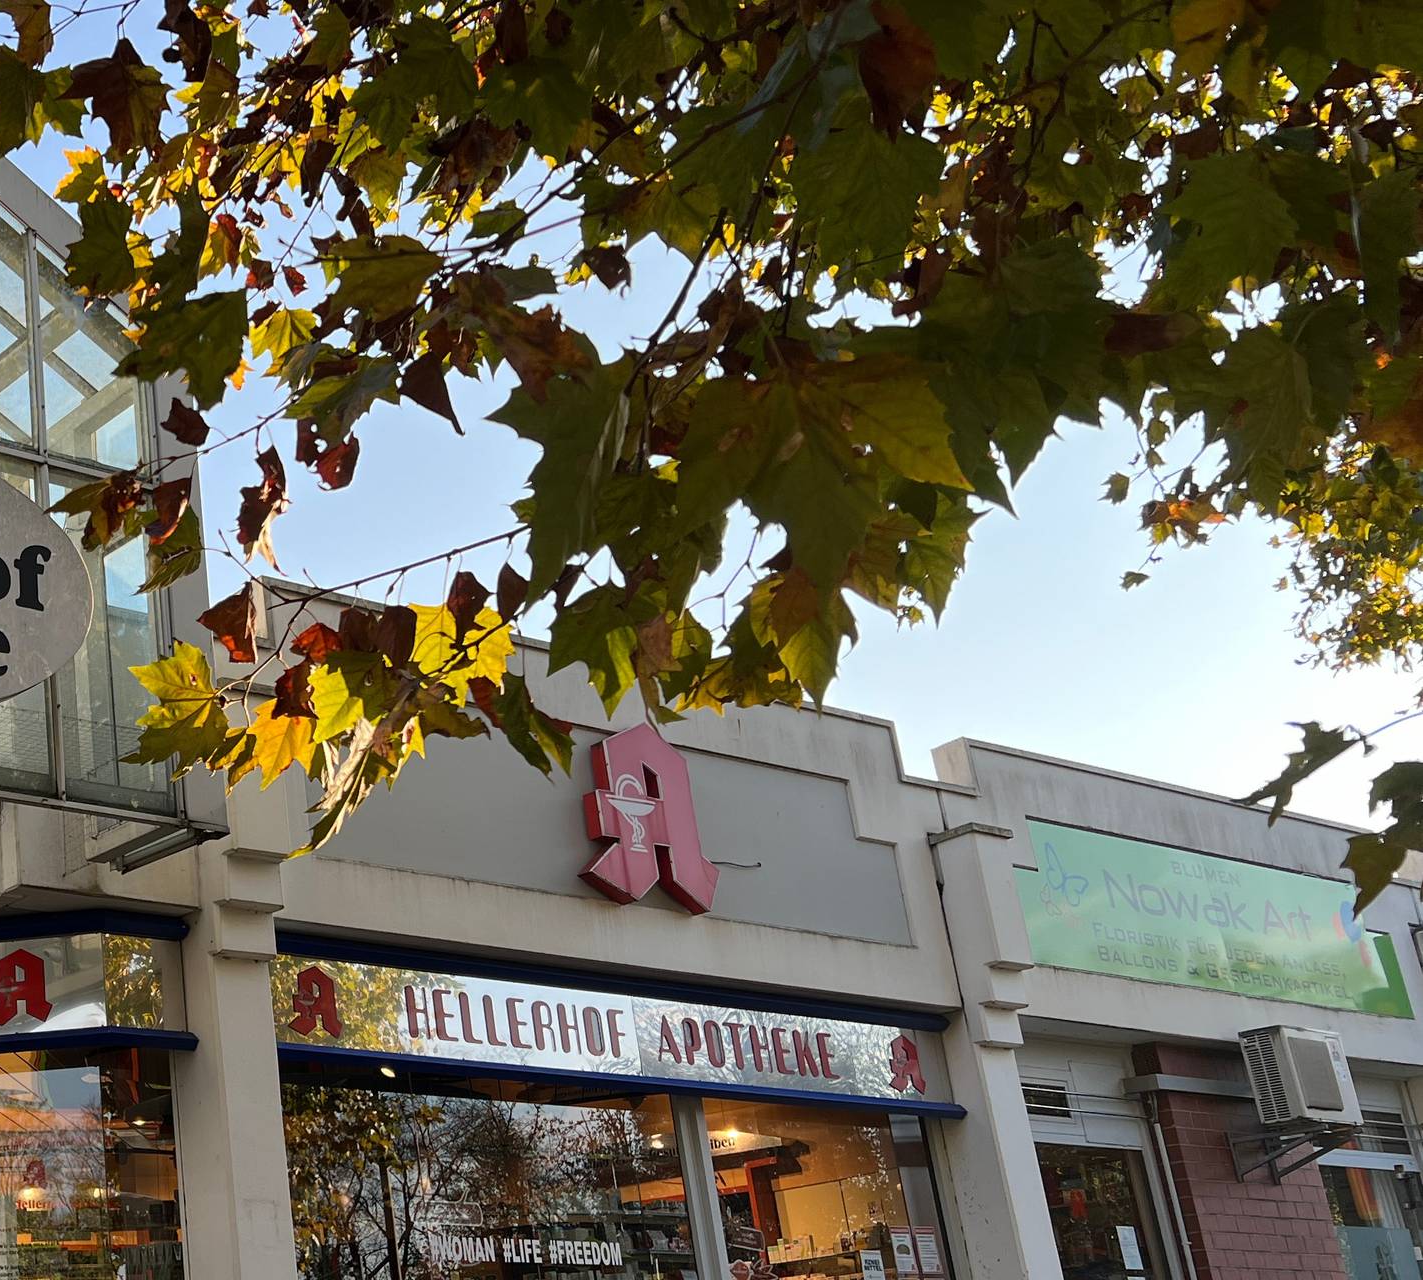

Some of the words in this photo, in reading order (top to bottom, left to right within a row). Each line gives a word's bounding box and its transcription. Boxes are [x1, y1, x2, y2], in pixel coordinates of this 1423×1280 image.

[1171, 860, 1242, 888] BLUMEN
[1264, 900, 1312, 941] Art
[1091, 922, 1181, 952] FLORISTIK
[1186, 937, 1218, 956] FÜR
[1226, 945, 1276, 967] JEDEN
[1097, 944, 1179, 973] BALLONS
[404, 985, 624, 1058] HELLERHOF
[658, 1014, 841, 1080] APOTHEKE
[428, 1233, 496, 1263] #WOMAN
[502, 1237, 543, 1264] #LIFE
[548, 1239, 623, 1267] #FREEDOM
